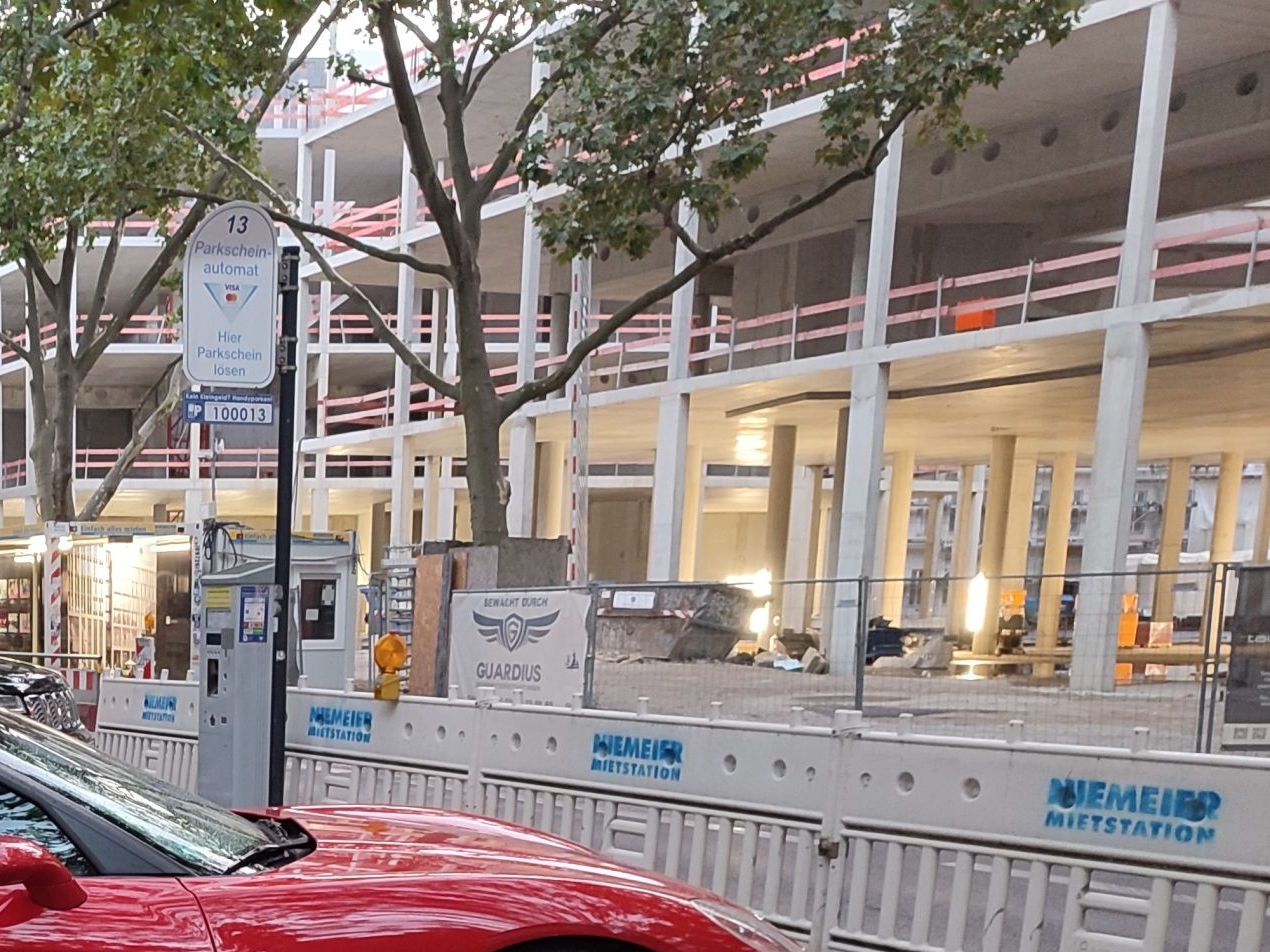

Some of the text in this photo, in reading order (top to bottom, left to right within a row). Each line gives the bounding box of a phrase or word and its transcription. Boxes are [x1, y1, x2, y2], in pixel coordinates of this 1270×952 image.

[227, 215, 249, 234] 13
[194, 240, 272, 259] Parkschein-
[203, 262, 259, 277] automat
[224, 283, 240, 292] VISA
[217, 330, 242, 344] Hier
[197, 346, 262, 361] Parkschein
[213, 363, 246, 377] lösen
[213, 406, 266, 422] 100013
[484, 597, 548, 608] BEWACHT DURCH
[476, 662, 542, 683] GUARDIUS
[309, 705, 373, 730] NIEMEIER
[307, 726, 372, 745] MIETSTATION
[592, 732, 684, 766] NIEMEIER
[590, 757, 682, 782] MIETSTATION
[1046, 777, 1222, 822] NIEMEIER
[1043, 811, 1216, 844] MIETSTATION
